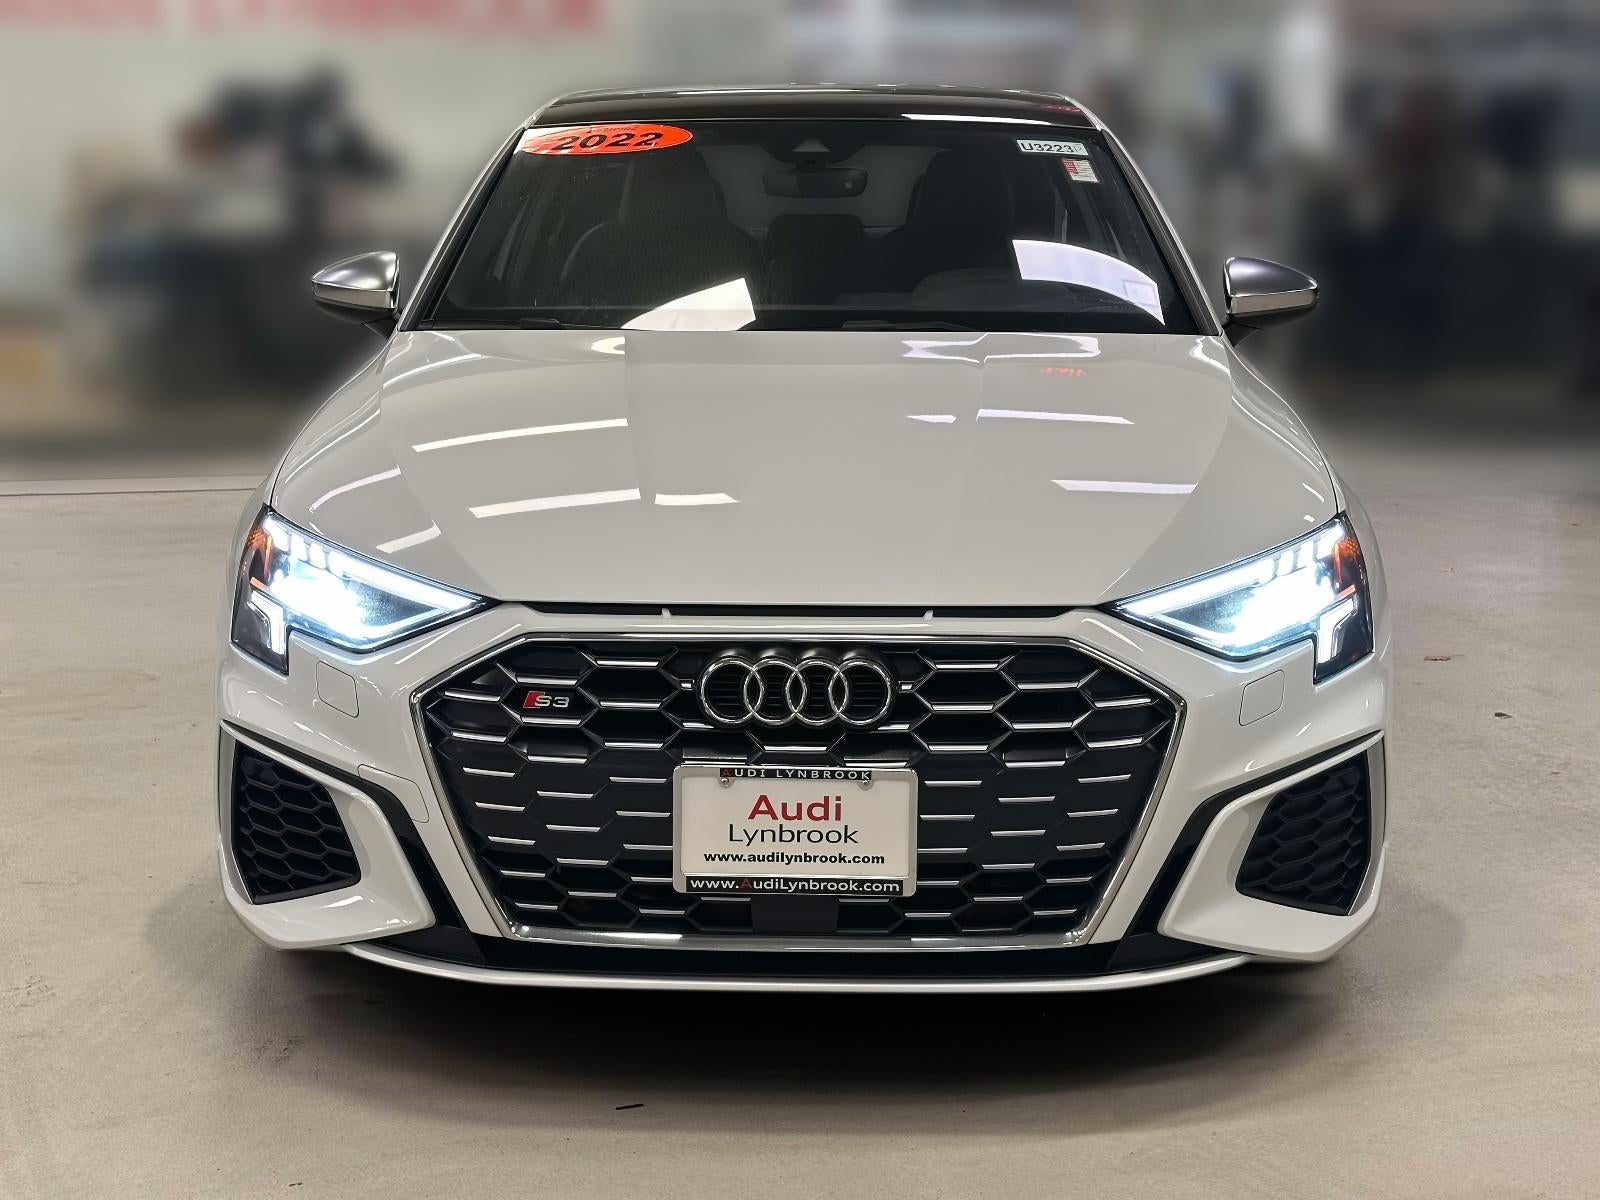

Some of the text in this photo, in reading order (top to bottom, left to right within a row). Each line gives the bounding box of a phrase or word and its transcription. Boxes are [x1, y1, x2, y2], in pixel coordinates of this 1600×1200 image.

[552, 133, 664, 150] 2022
[534, 695, 570, 708] S3
[722, 768, 870, 780] AUDI LYNBROOK
[748, 794, 842, 821] Audi
[728, 823, 859, 846] Lynbrook
[703, 851, 885, 865] www.audilynbrook.com
[690, 878, 900, 893] www.AudiLynbrook.com
